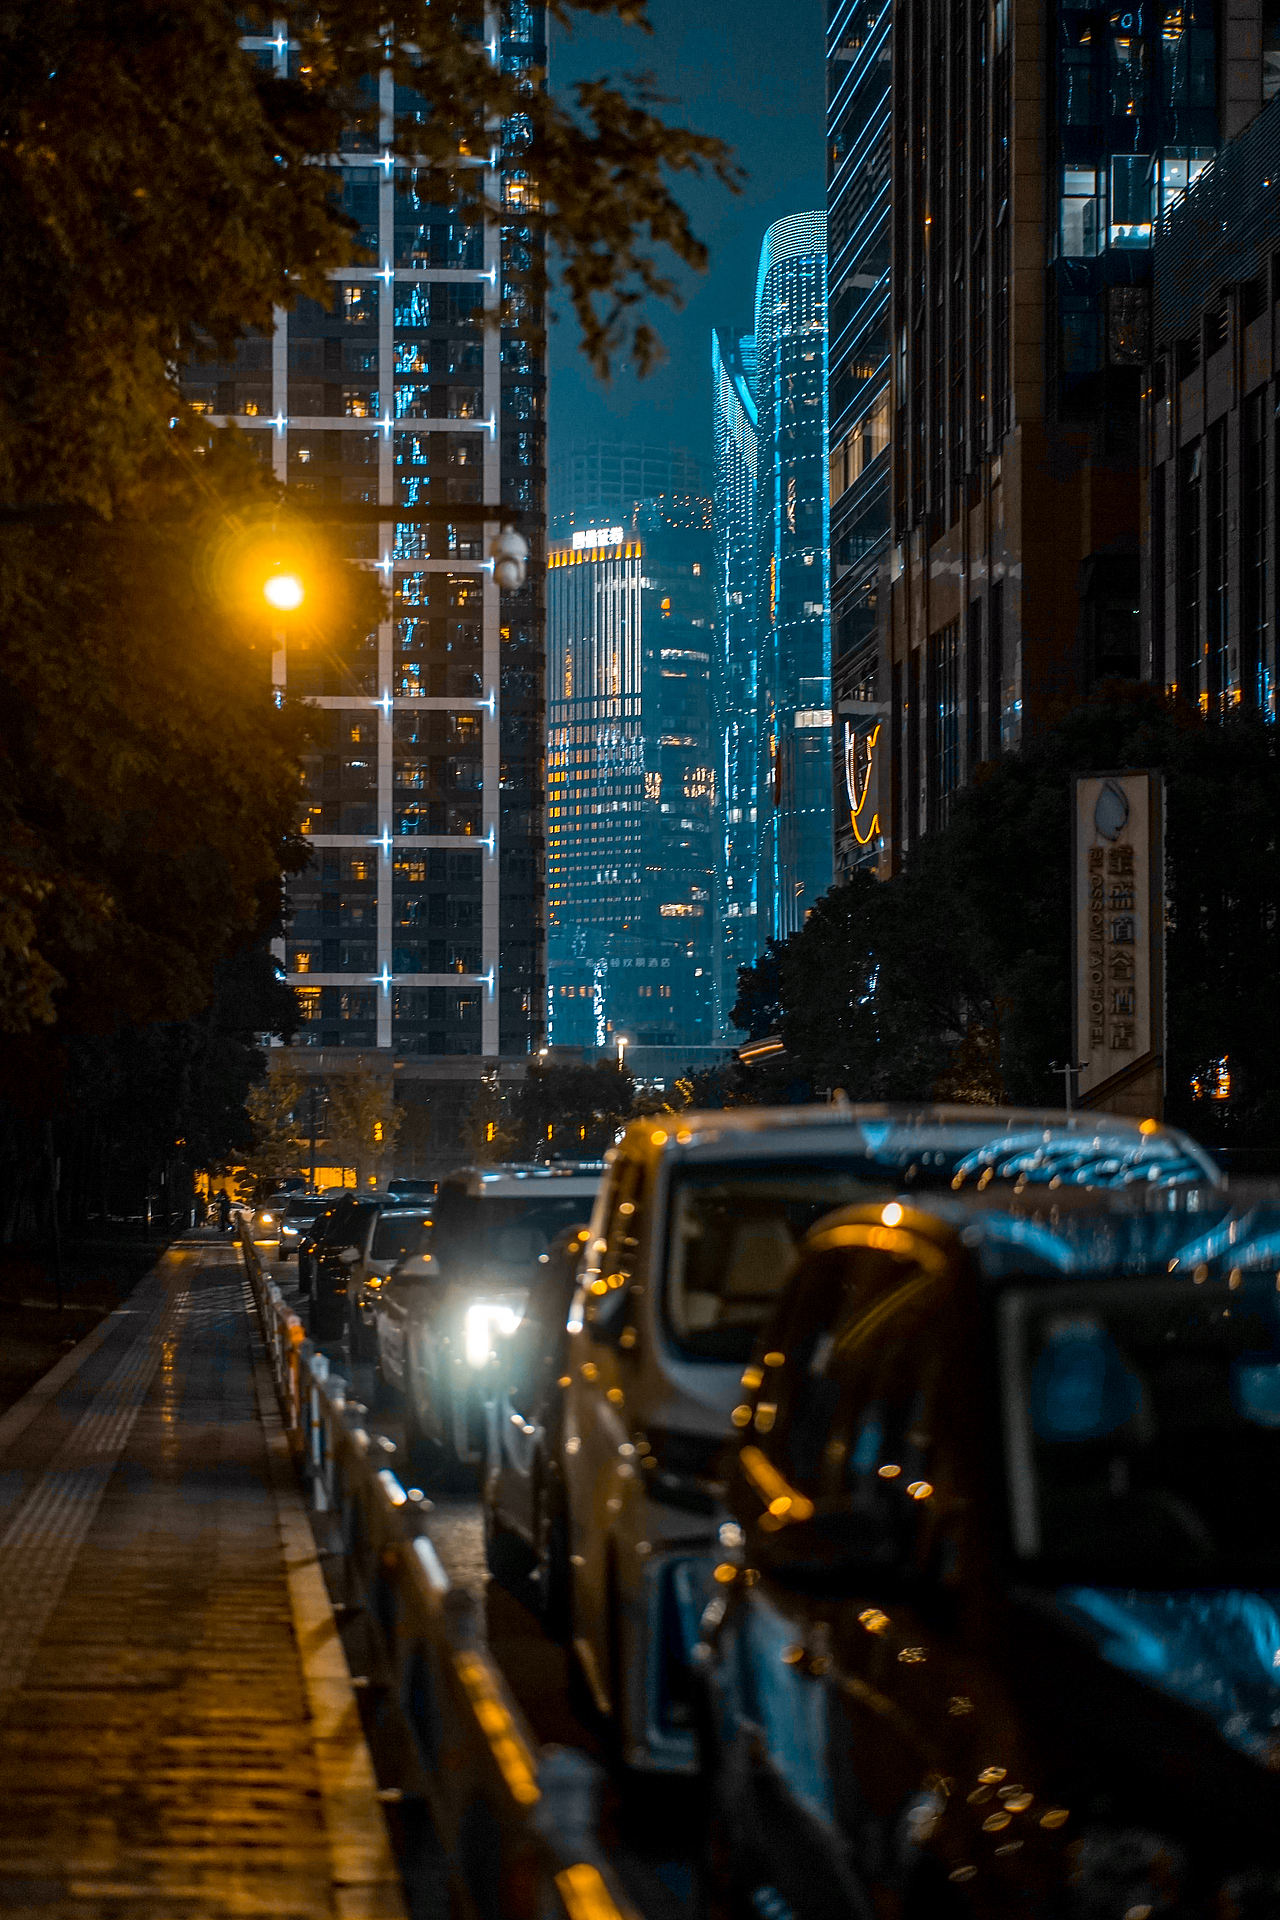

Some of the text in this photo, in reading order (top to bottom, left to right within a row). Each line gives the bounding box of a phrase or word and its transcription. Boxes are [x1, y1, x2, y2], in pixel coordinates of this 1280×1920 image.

[1089, 848, 1105, 1049] BLOSSOM TAO HOTEL
